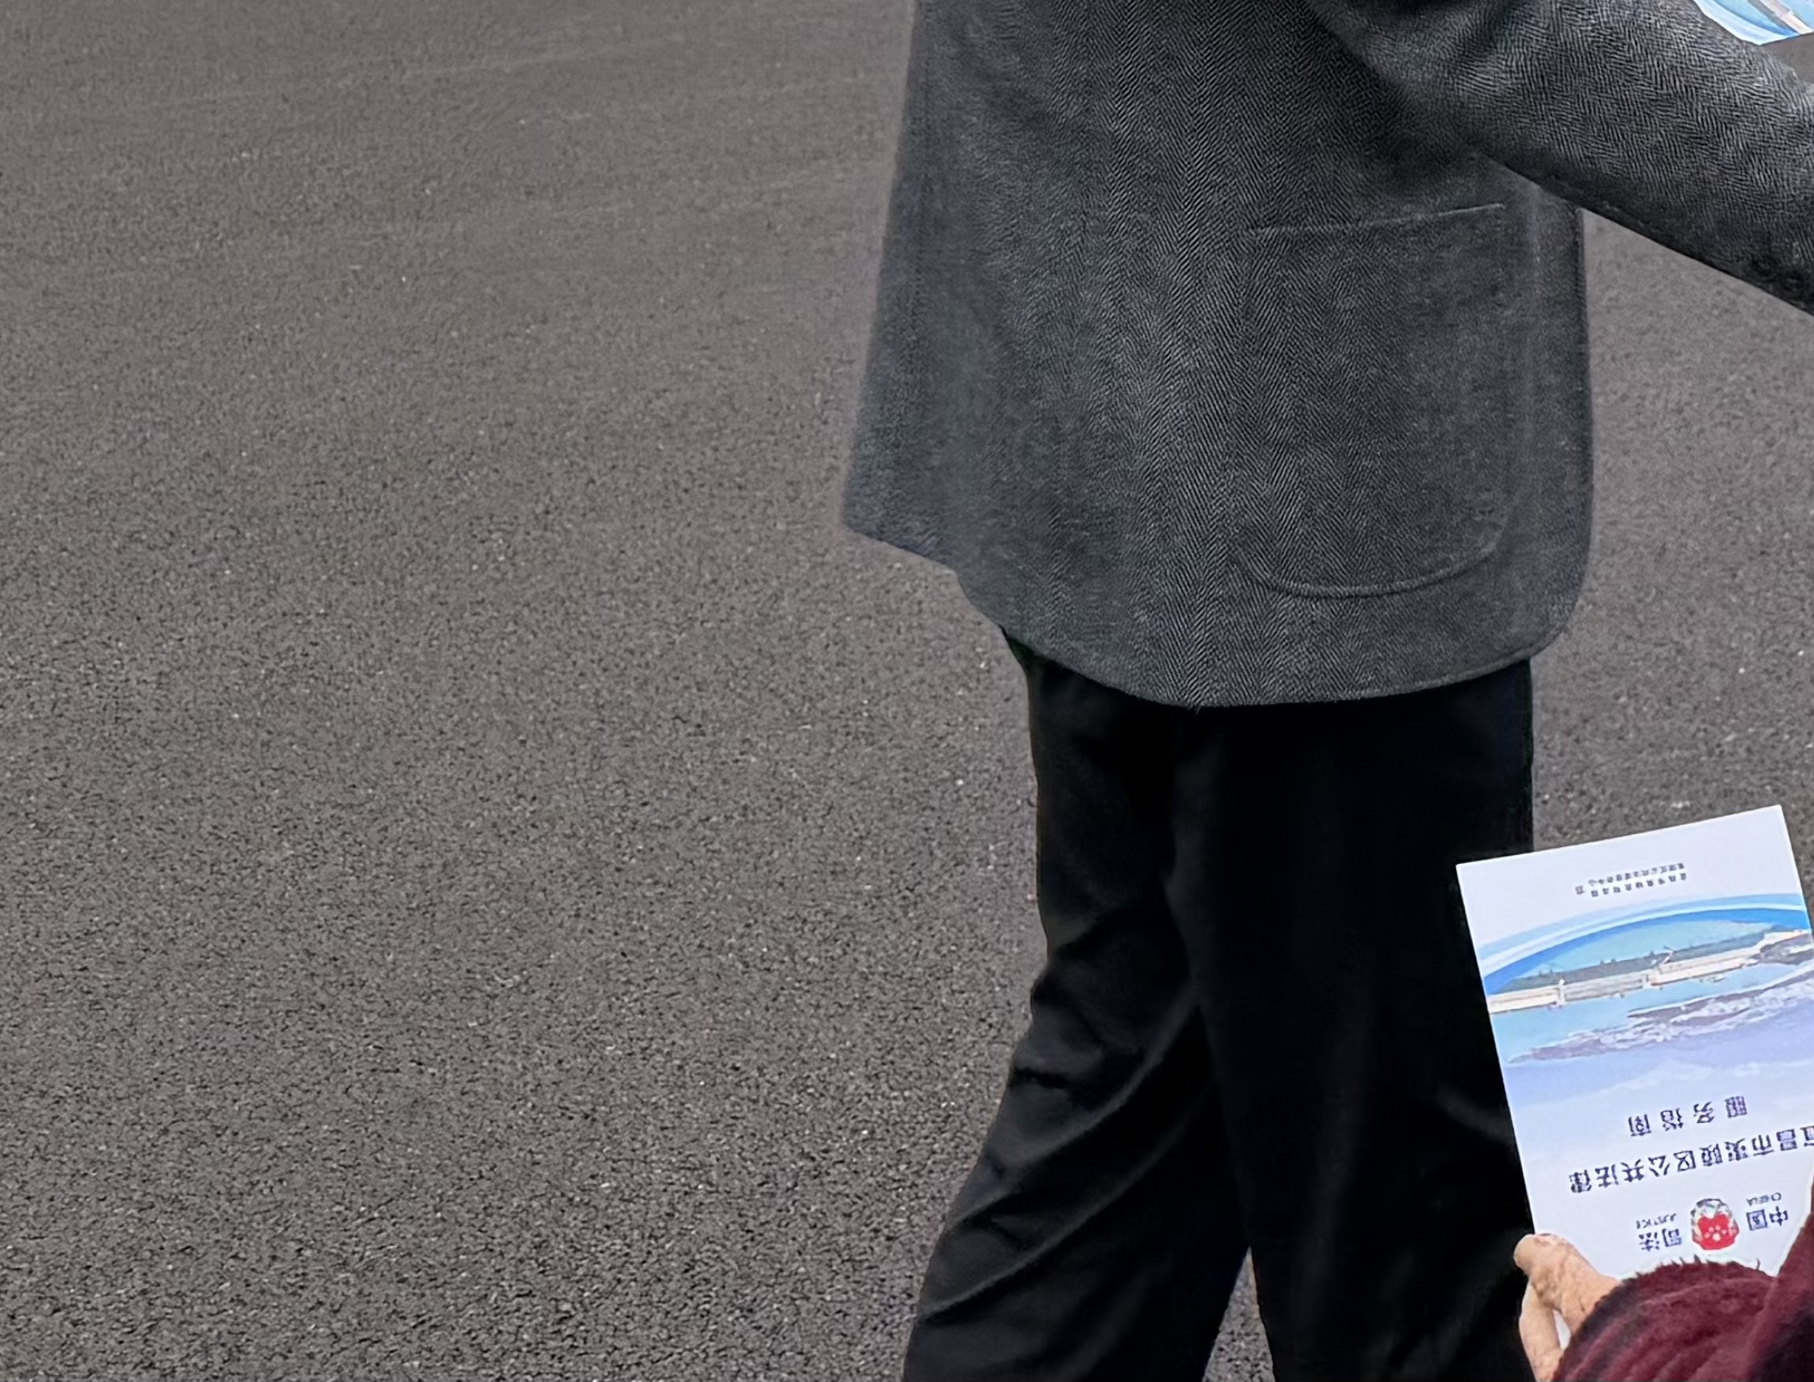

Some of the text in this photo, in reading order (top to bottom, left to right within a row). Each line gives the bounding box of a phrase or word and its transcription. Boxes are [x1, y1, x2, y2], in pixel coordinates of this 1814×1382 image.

[1628, 1095, 1748, 1137] 服务指南
[1746, 1205, 1789, 1232] 中国
[1638, 1228, 1682, 1252] 司法
